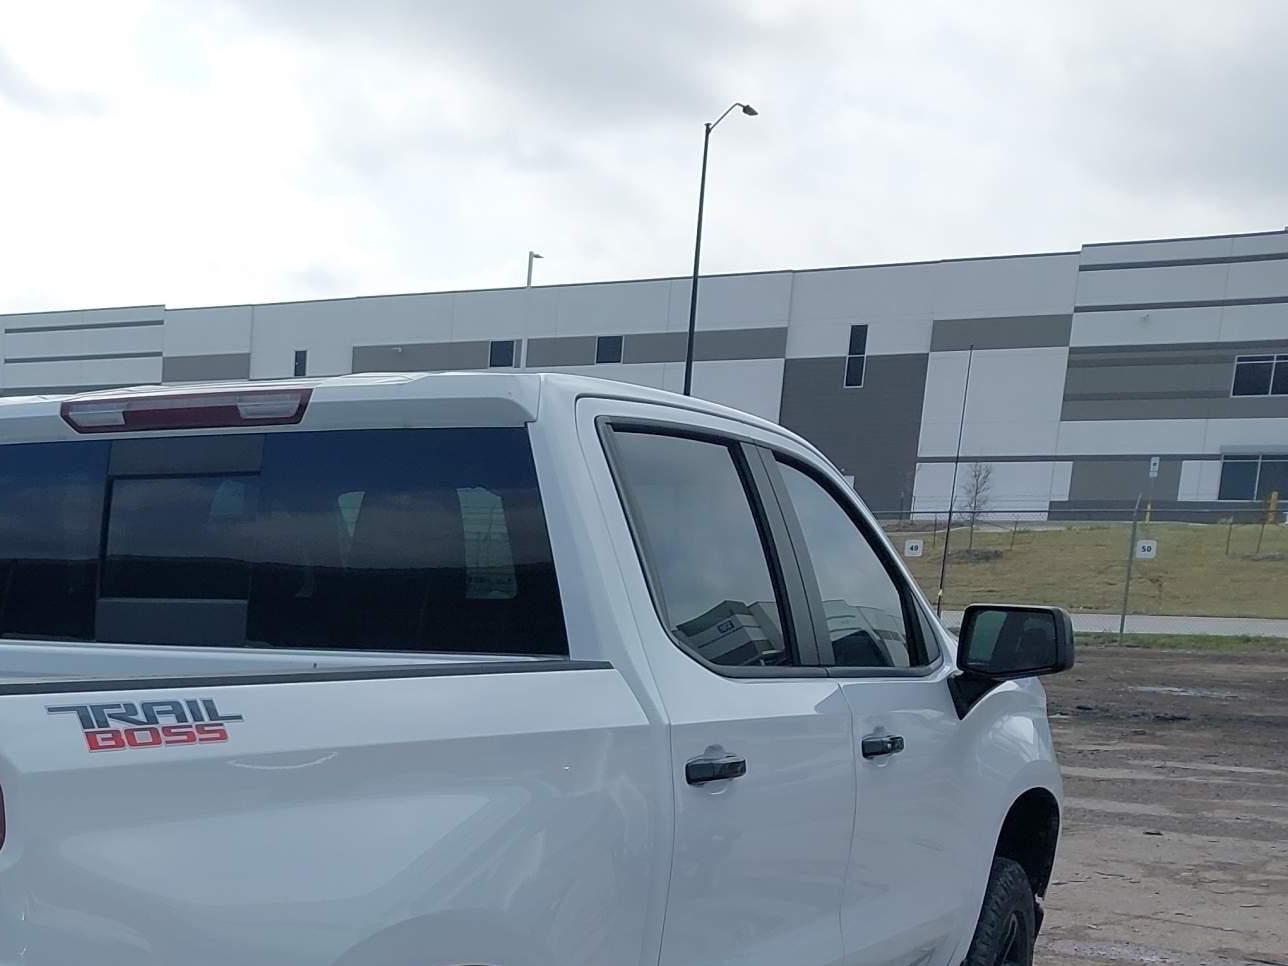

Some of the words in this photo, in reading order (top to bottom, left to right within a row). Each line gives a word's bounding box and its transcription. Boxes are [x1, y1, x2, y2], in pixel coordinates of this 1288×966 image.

[1141, 545, 1152, 553] 50
[46, 698, 244, 730] TRAIL
[84, 722, 229, 752] BOSS
